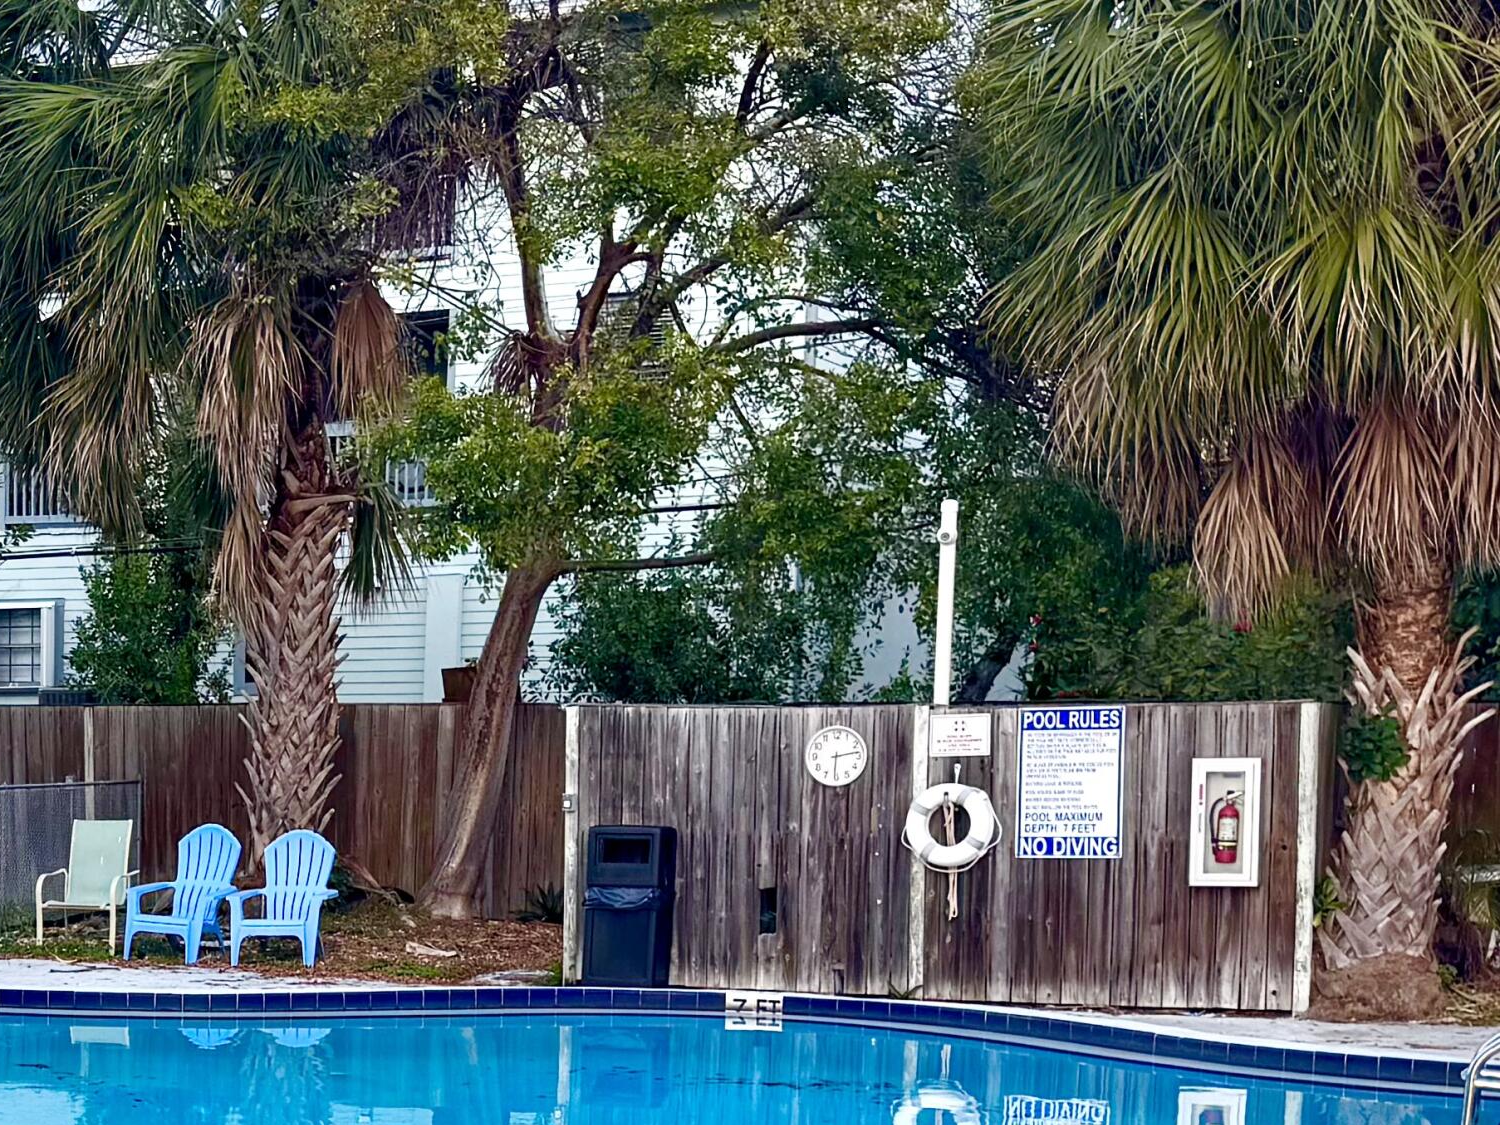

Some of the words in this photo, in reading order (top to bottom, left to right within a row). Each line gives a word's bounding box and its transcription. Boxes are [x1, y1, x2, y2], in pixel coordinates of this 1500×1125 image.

[1023, 711, 1066, 729] POOL
[1069, 710, 1120, 729] RULES
[1025, 812, 1051, 822] POOL
[1055, 812, 1103, 822] MAXIMUM
[1024, 824, 1057, 833] DEPTH
[1072, 824, 1096, 833] FEET
[1020, 837, 1047, 856] NO
[1053, 837, 1118, 856] DIVING
[733, 998, 747, 1013] 7
[756, 998, 781, 1014] FT
